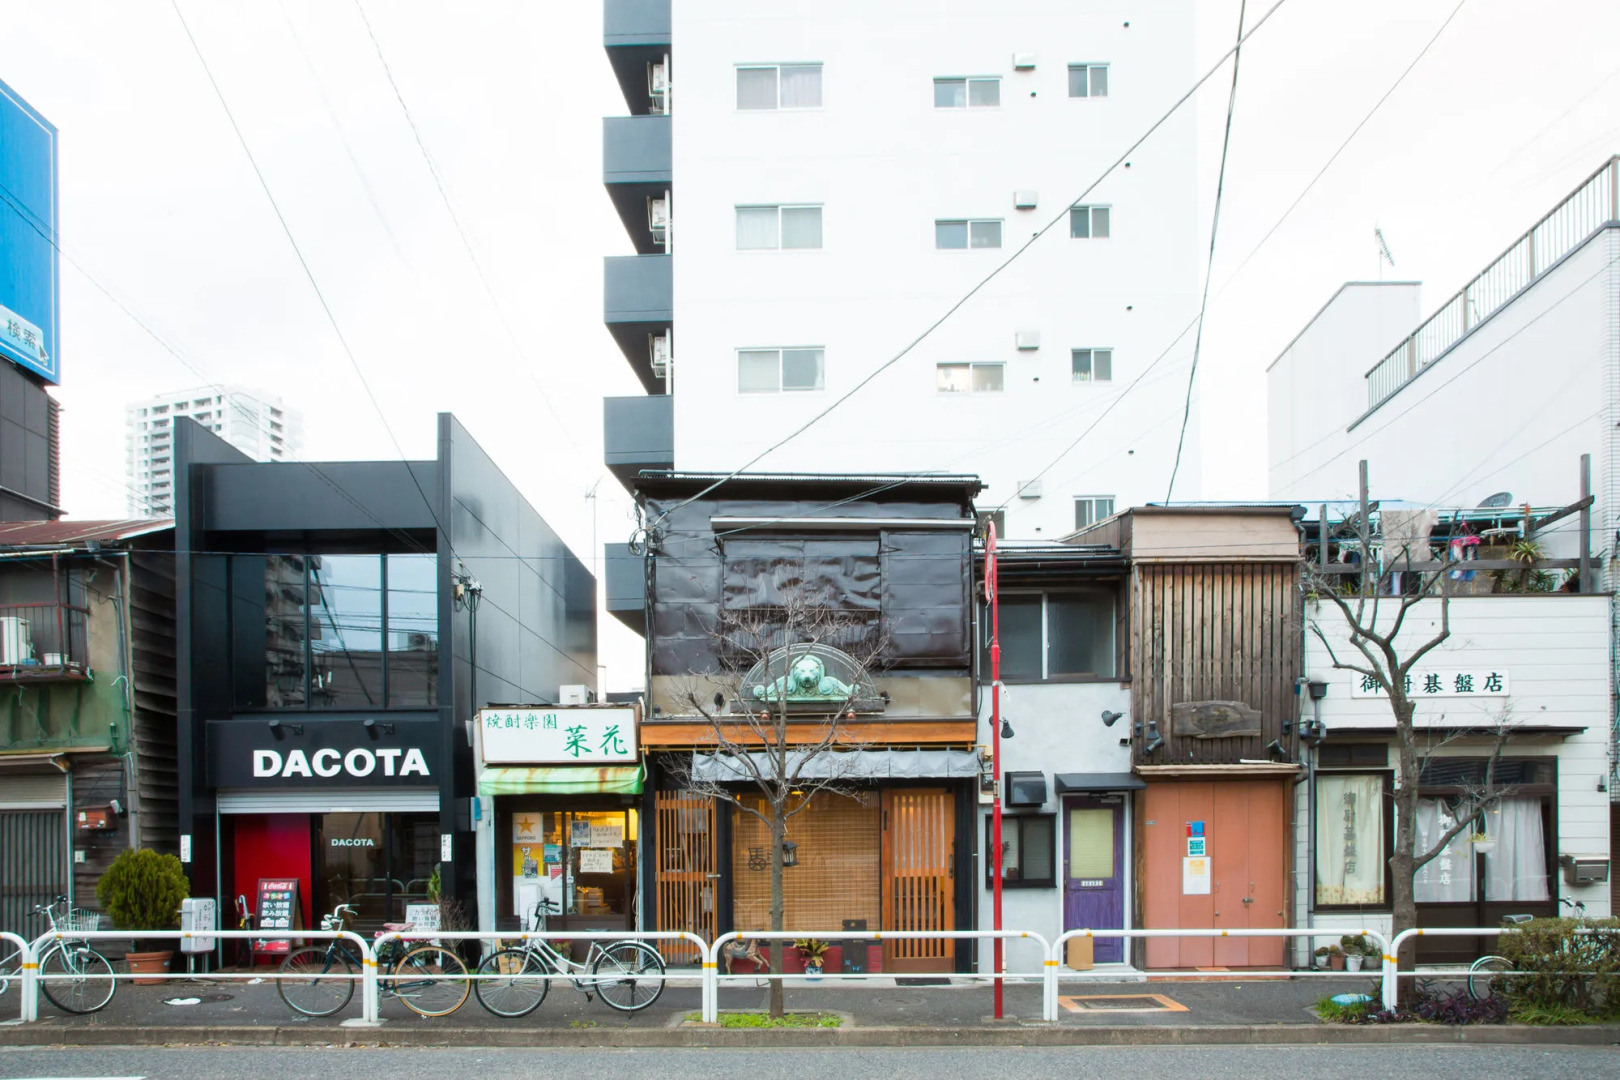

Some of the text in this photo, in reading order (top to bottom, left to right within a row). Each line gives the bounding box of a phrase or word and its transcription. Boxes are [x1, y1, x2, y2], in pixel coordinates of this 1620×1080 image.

[7, 319, 36, 350] 検索
[486, 712, 558, 730] 焼酎楽園
[563, 724, 628, 758] 菜花
[253, 748, 431, 778] DACOTA
[331, 838, 374, 847] DACOTA
